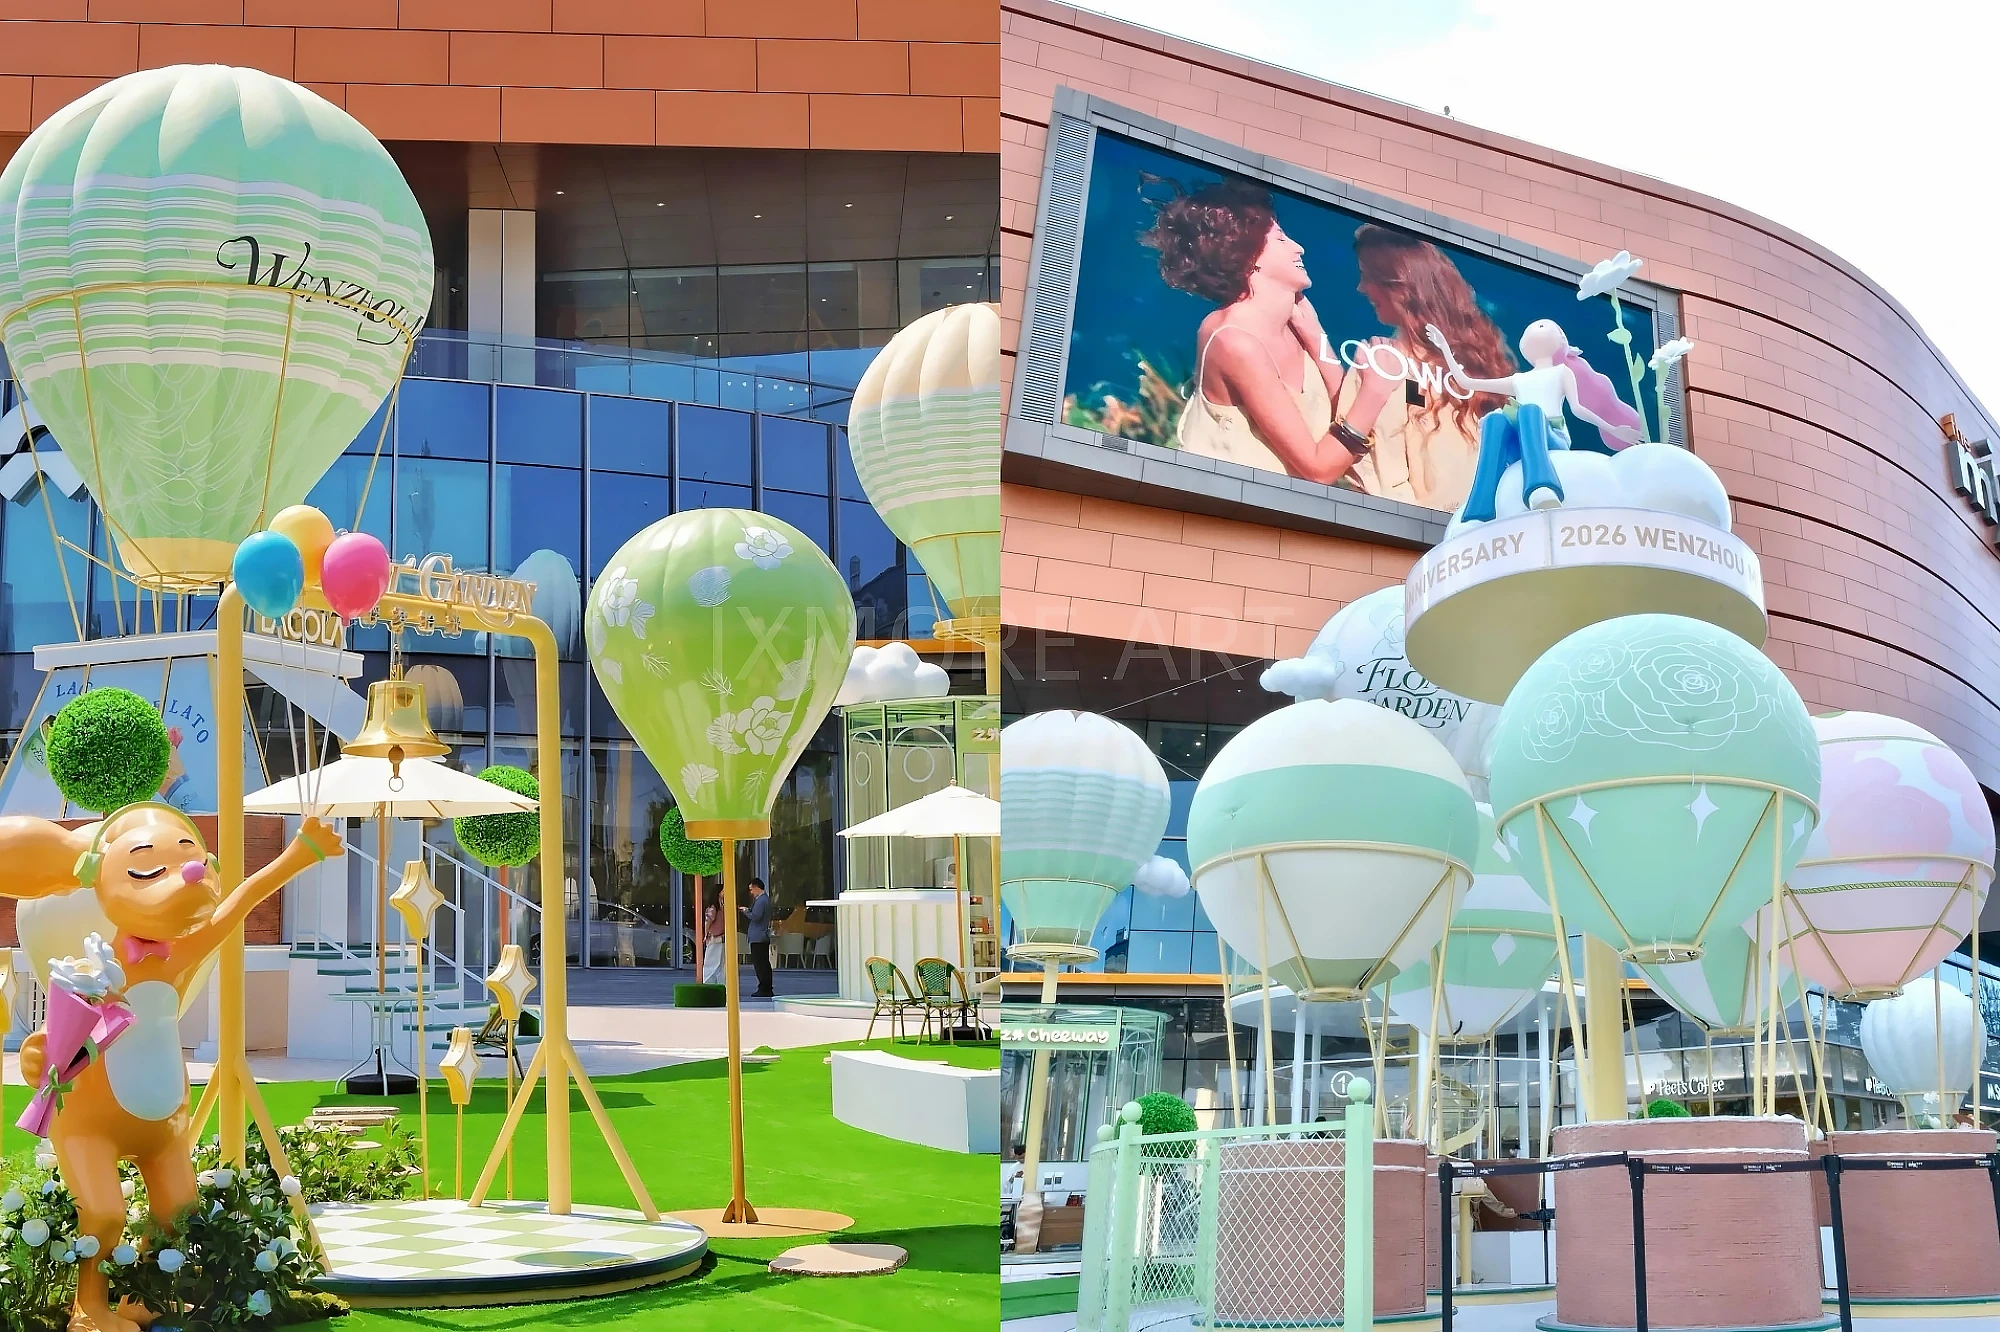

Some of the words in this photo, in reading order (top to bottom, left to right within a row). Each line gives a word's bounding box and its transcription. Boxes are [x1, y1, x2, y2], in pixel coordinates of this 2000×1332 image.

[1560, 524, 1627, 548] 2026
[1634, 525, 1745, 576] WENZHOU
[1357, 655, 1438, 693] FLO
[1367, 693, 1473, 729] ARDEN
[1027, 1027, 1110, 1044] Cheeway
